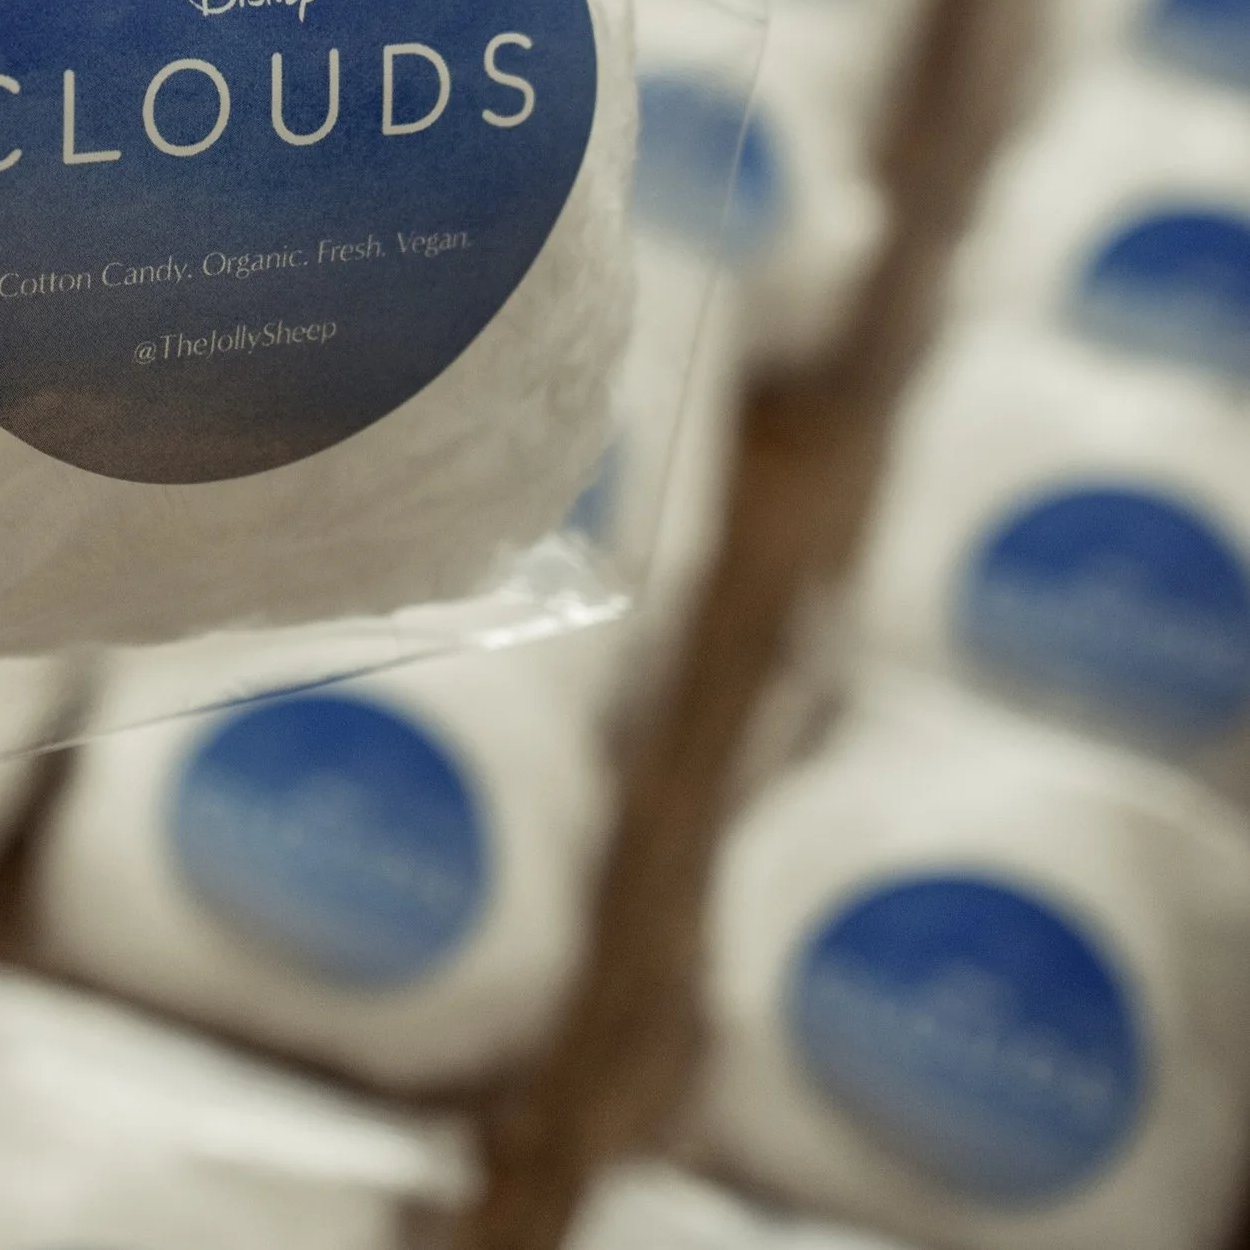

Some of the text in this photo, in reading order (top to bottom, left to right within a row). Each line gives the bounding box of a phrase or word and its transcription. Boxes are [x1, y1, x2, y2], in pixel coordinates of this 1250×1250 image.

[101, 257, 193, 288] Candy.
[202, 246, 309, 280] Organic.
[317, 233, 386, 265] Fresh.
[132, 318, 338, 365] @TheJollySheep
